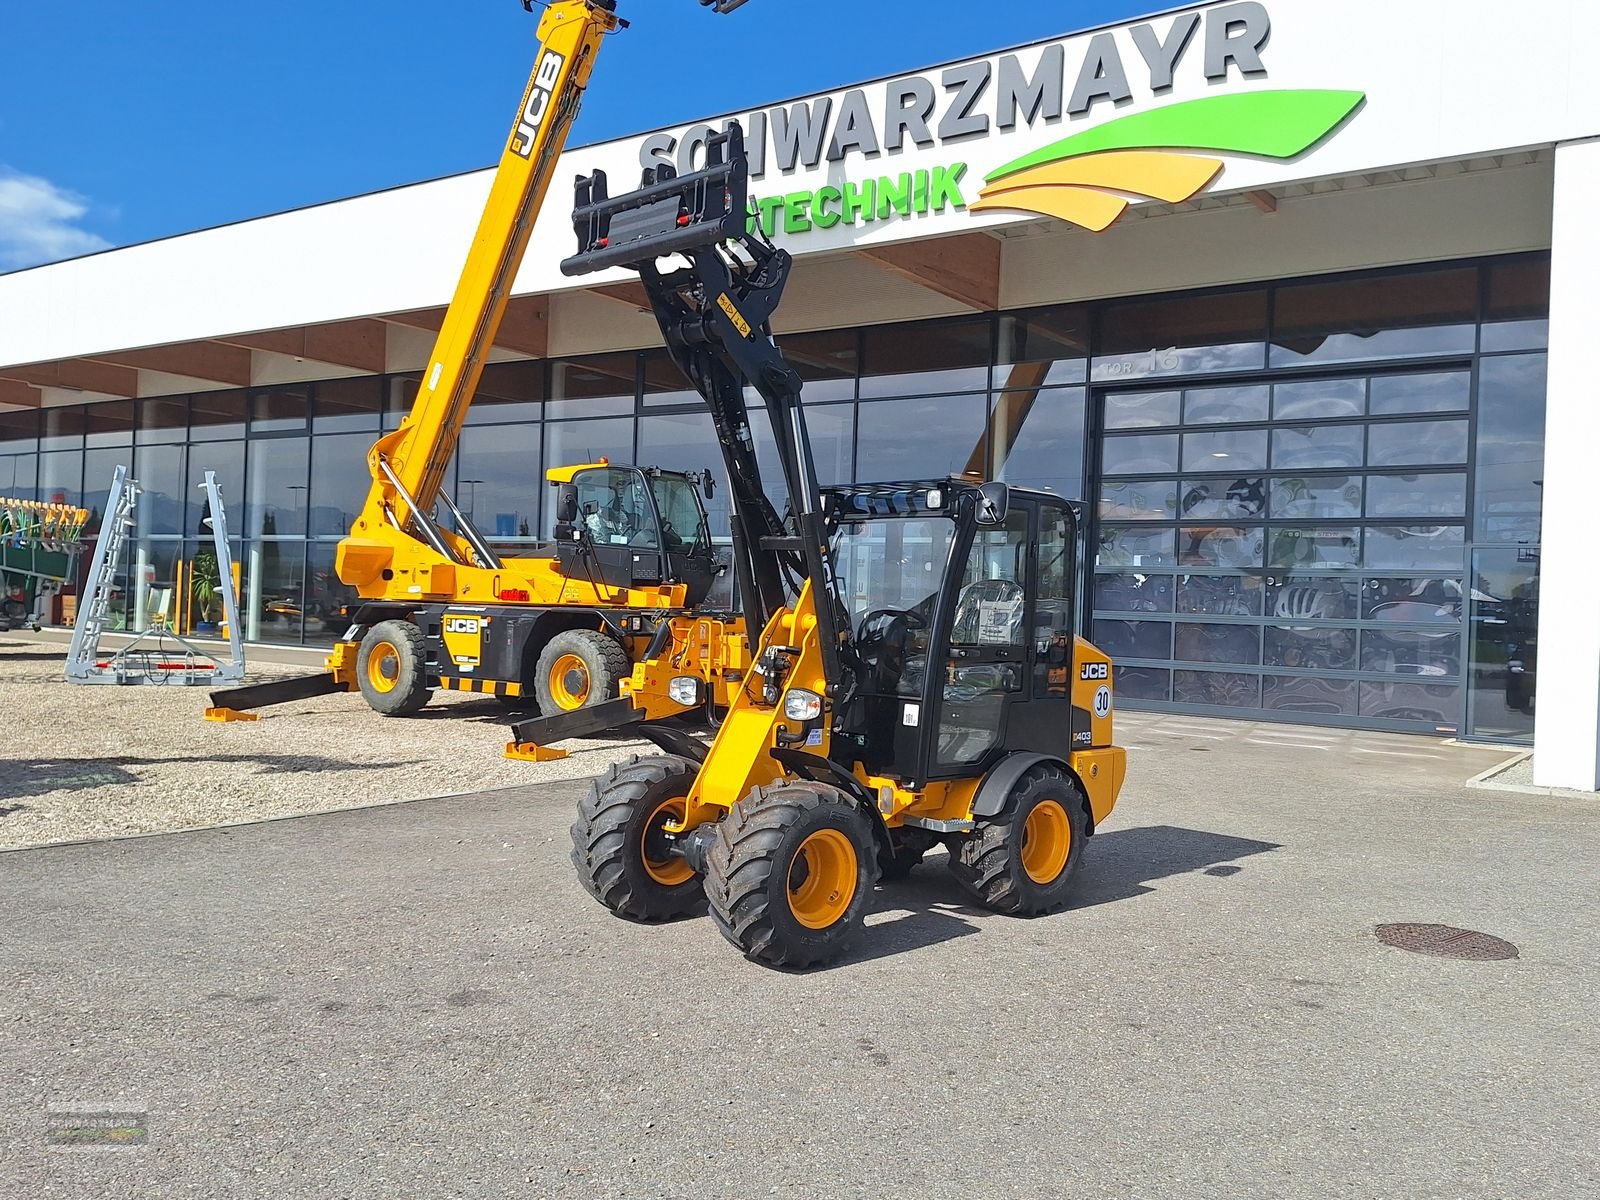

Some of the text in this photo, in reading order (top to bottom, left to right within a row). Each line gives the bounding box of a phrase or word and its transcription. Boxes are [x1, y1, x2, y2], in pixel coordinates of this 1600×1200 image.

[518, 52, 562, 156] JCB
[746, 162, 968, 238] TECHNIK
[1105, 346, 1179, 375] TOR 16
[446, 618, 478, 633] JCB
[1081, 663, 1108, 679] JCB
[1096, 691, 1109, 711] 30
